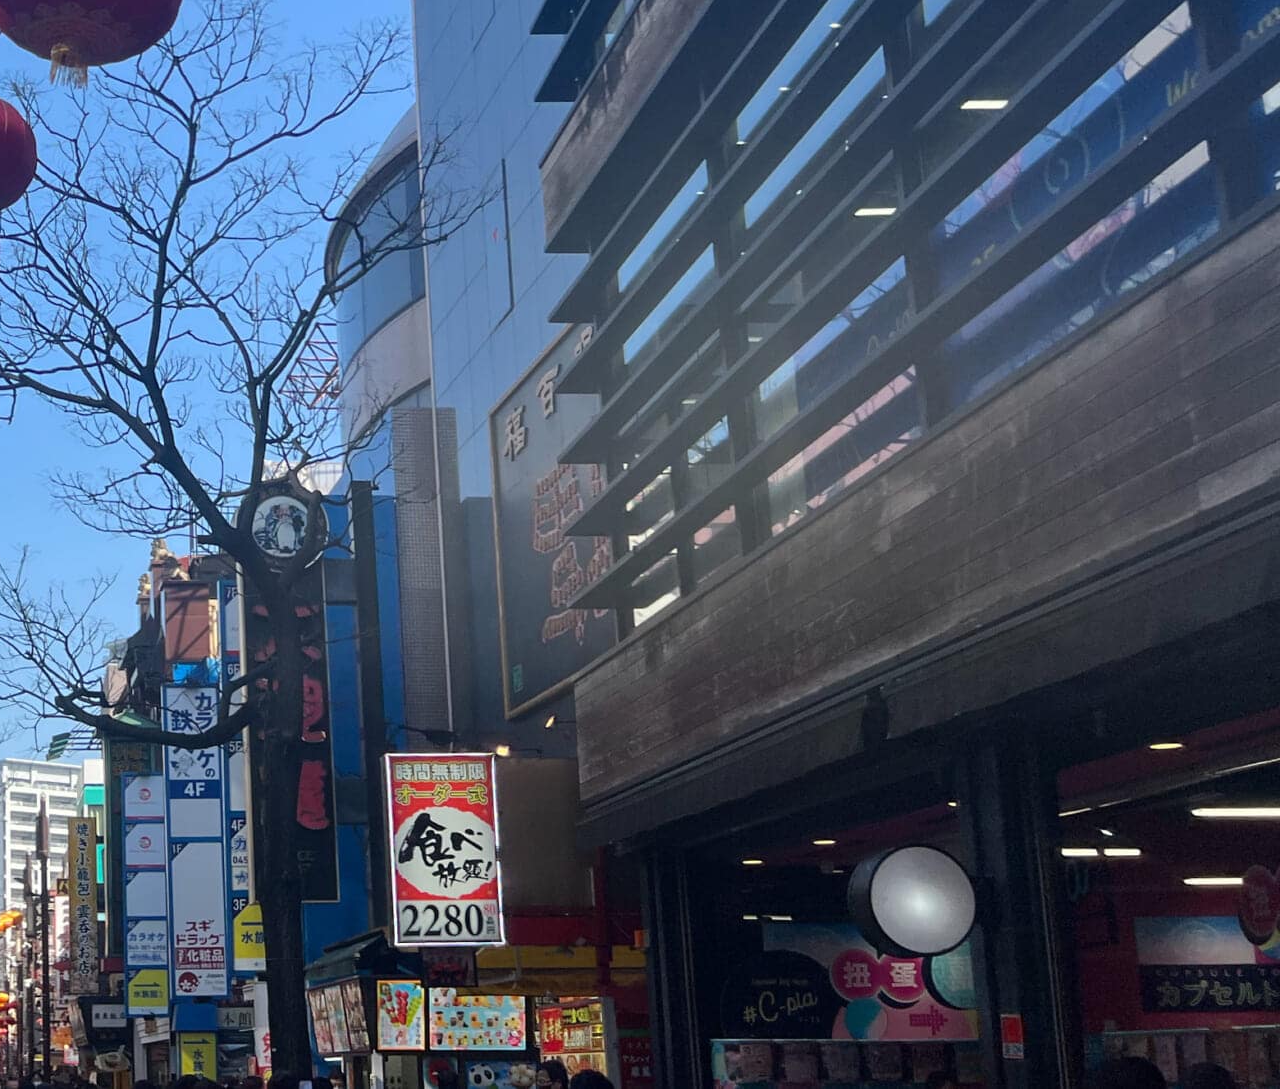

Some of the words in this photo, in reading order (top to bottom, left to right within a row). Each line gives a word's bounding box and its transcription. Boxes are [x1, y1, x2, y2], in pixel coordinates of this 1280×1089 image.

[395, 762, 486, 781] 時間無制限
[183, 782, 206, 797] 4F
[396, 784, 488, 805] オーダー式
[231, 819, 245, 832] 4F
[398, 812, 483, 867] 食べ
[172, 843, 183, 855] 1F
[432, 860, 493, 888] 放題!
[232, 898, 246, 911] 3F
[185, 919, 215, 932] スギ
[402, 903, 484, 937] 2280
[129, 932, 165, 942] カラオケ
[176, 933, 224, 946] ドラッグ
[187, 948, 225, 962] 化粧品
